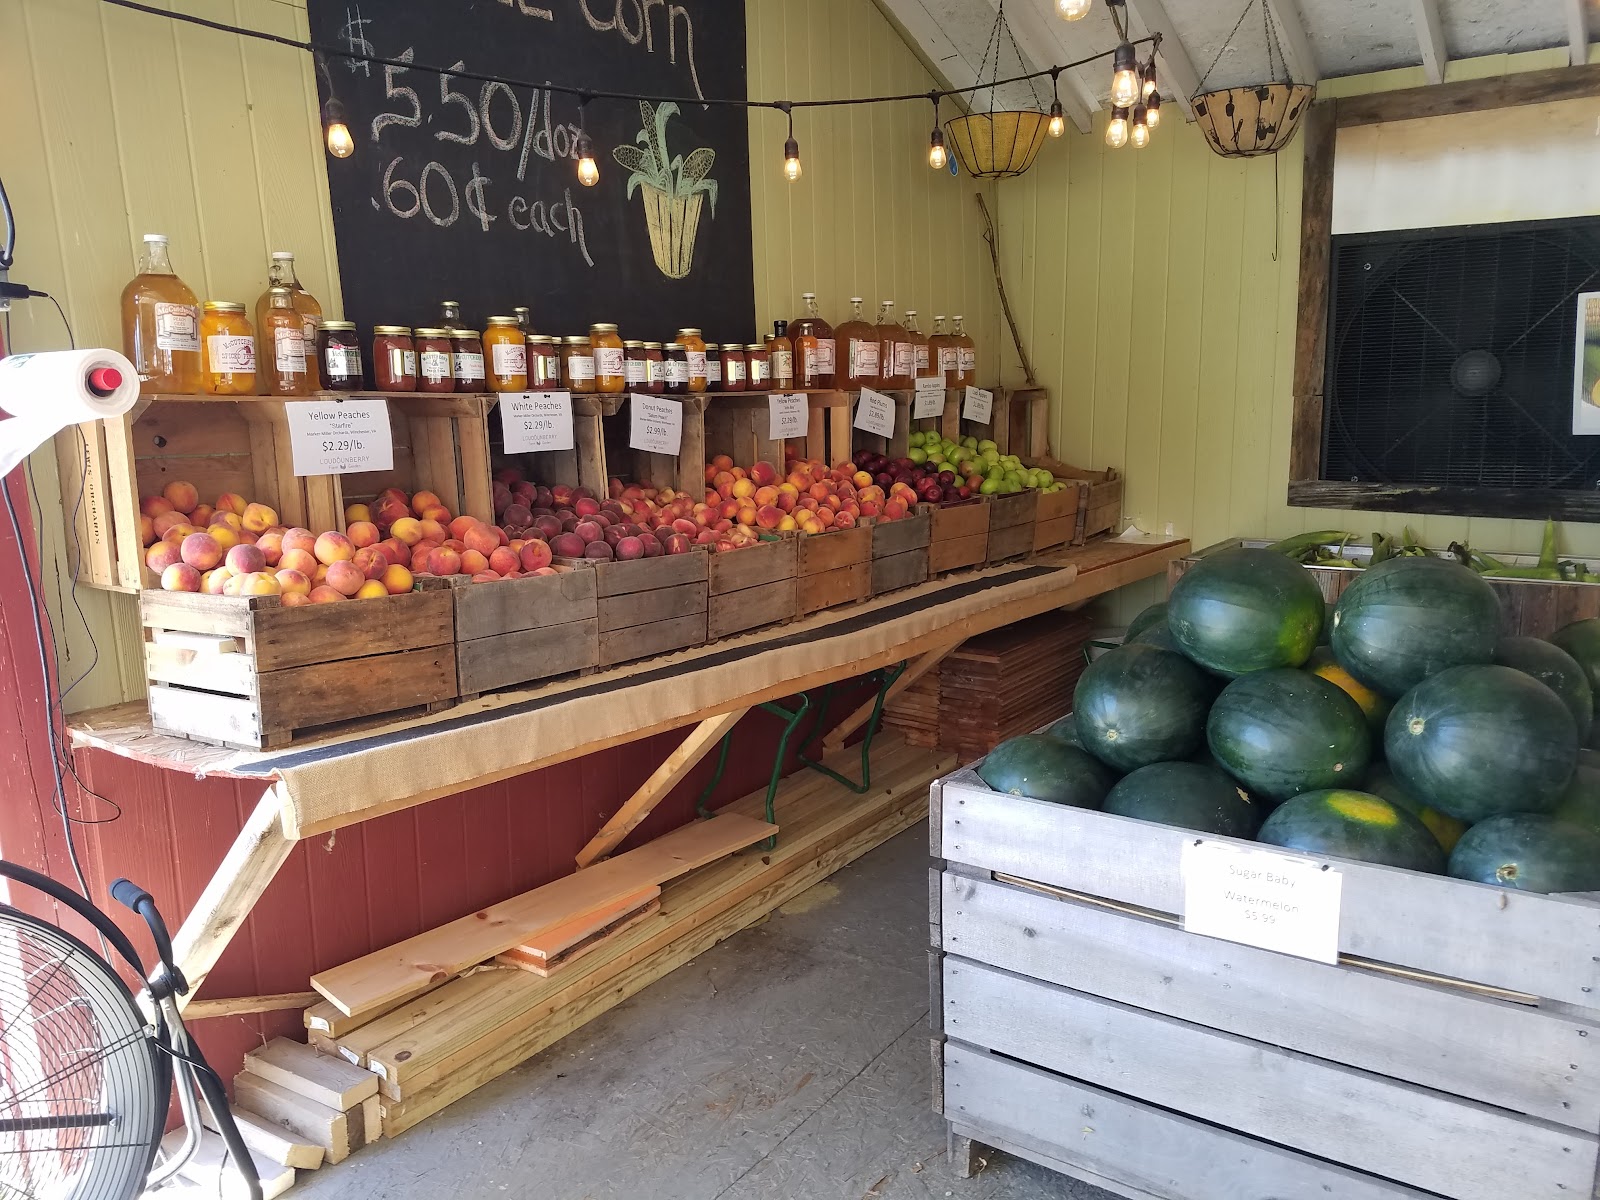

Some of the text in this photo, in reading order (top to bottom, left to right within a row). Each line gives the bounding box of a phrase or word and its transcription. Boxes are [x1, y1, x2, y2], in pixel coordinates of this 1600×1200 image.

[507, 188, 595, 268] each
[511, 401, 562, 411] White Peaches
[308, 410, 371, 421] Yellow Peaches
[523, 420, 555, 430] $2.29/lb.
[322, 439, 366, 453] $2.29/lb.
[1229, 864, 1296, 888] Sugar Baby
[1224, 890, 1299, 912] Watermelon
